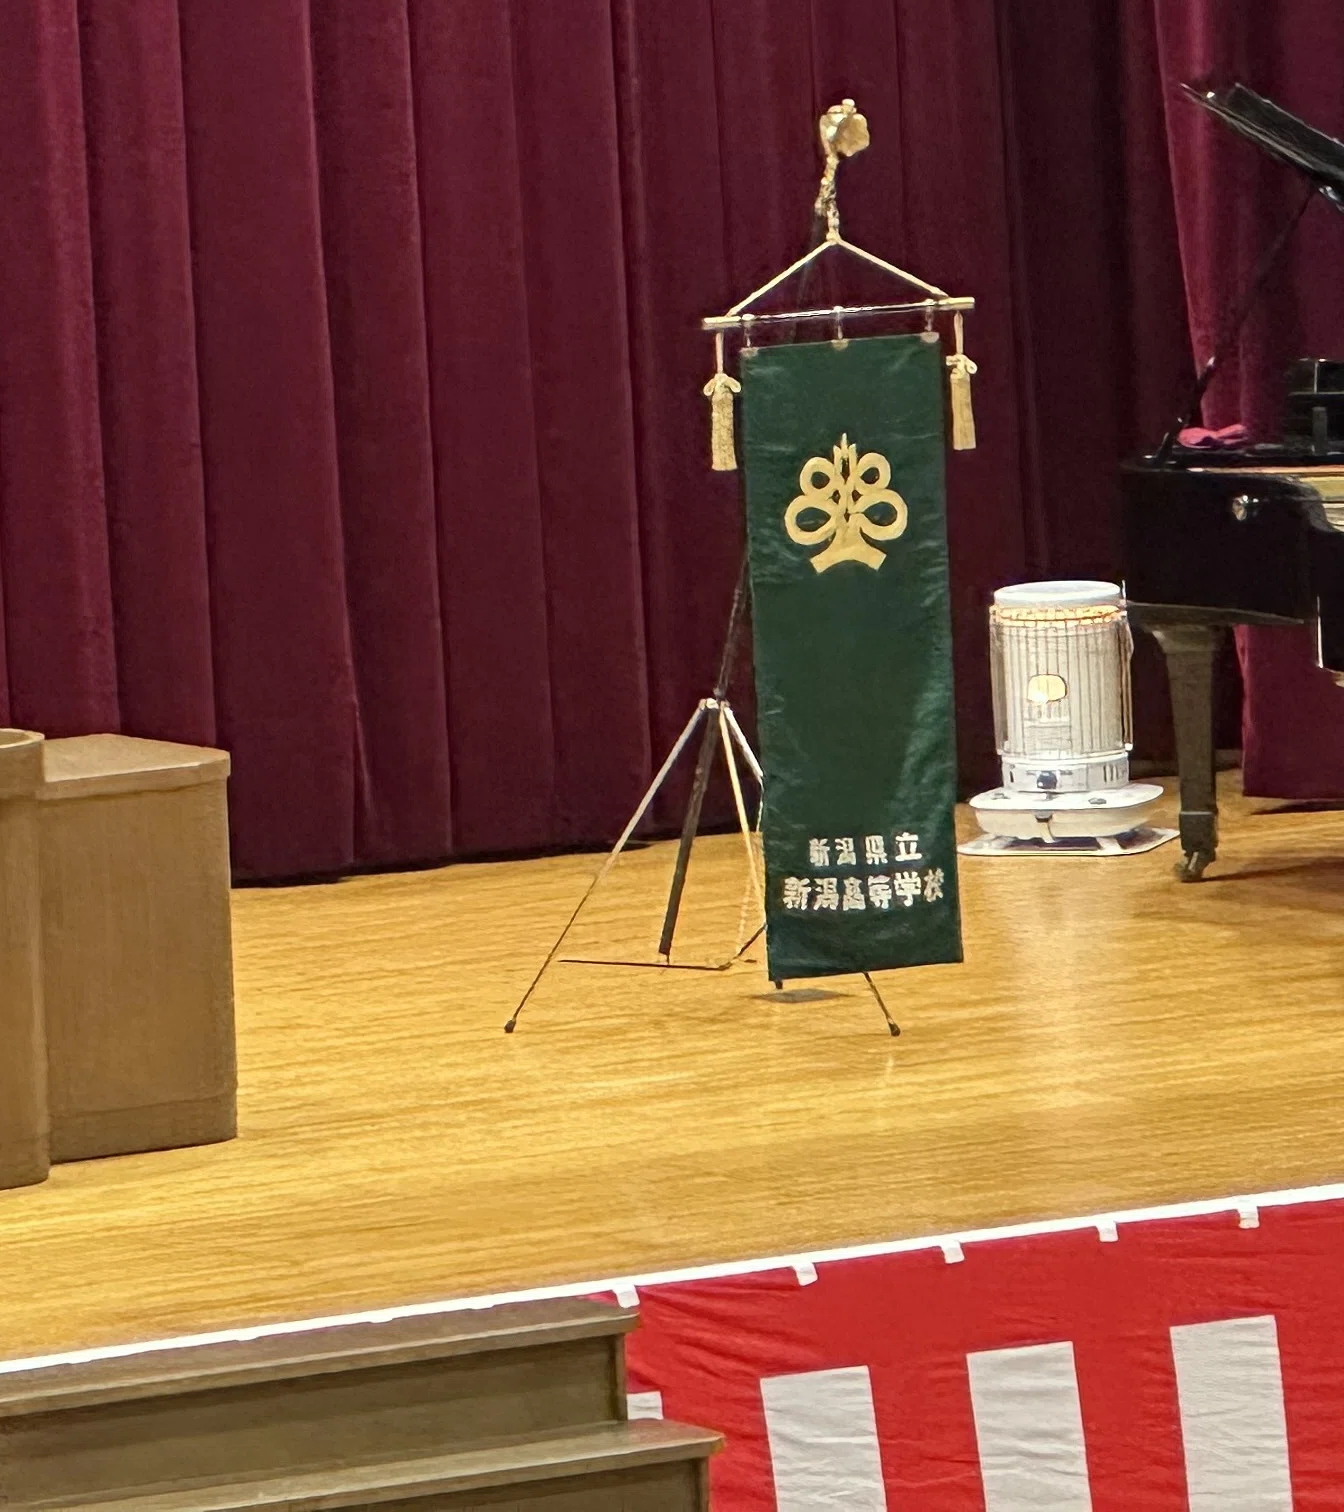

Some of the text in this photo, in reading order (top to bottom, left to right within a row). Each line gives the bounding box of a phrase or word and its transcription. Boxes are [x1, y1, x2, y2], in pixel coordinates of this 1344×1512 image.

[808, 831, 923, 868] 新潟県立
[781, 867, 946, 912] 新潟高等学校
